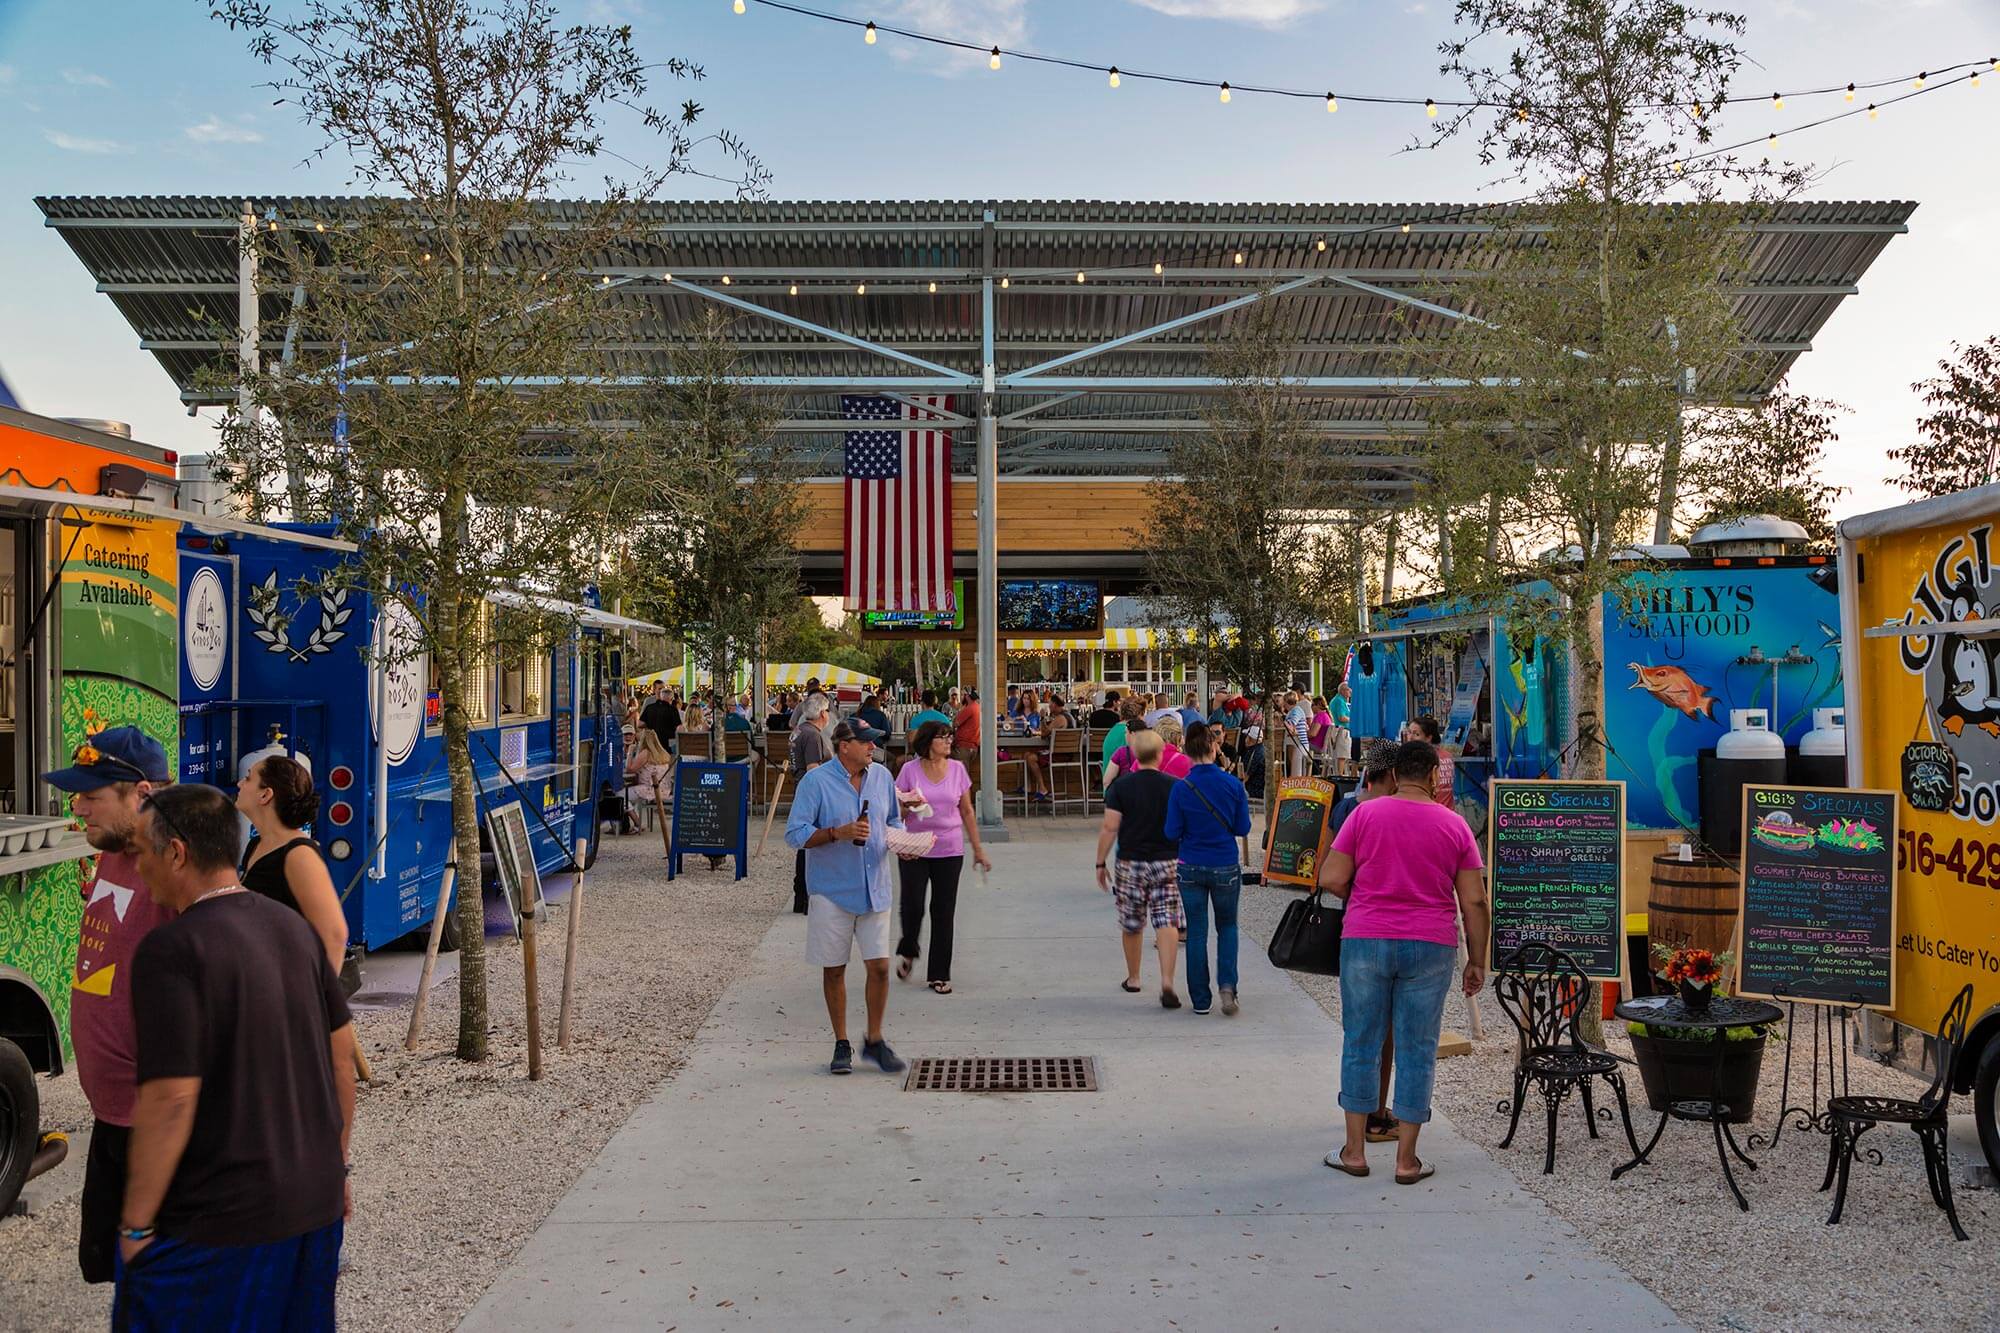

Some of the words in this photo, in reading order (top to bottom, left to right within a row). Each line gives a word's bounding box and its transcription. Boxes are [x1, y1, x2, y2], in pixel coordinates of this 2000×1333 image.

[84, 543, 149, 579] Catering
[80, 579, 153, 607] Available
[1629, 614, 1750, 645] SEAFOOD
[1907, 746, 1949, 764] OCTOPUS
[1281, 779, 1312, 790] SHOCK
[1315, 781, 1332, 793] TOP
[1803, 793, 1885, 816] SPECIALS
[1912, 793, 1943, 808] SALAD
[1499, 814, 1533, 827] GRILLED
[1533, 815, 1554, 827] LAMB
[1555, 815, 1582, 828] CHOPS
[1499, 847, 1528, 857] SPICY
[1530, 846, 1571, 857] SHRIMP
[1570, 854, 1607, 862] GREENS
[1754, 865, 1795, 879] GOURMET
[1798, 869, 1831, 880] ANGUS
[1837, 871, 1886, 883] BURGERS
[1539, 883, 1570, 893] FRENCH
[1571, 883, 1597, 894] FRIES
[1495, 899, 1525, 909] GRILLED
[1520, 931, 1546, 940] BRIE
[1750, 928, 1778, 937] GARDEN
[1780, 929, 1803, 939] FRESH
[1835, 932, 1870, 941] SALADS
[1917, 935, 1933, 957] Us
[1936, 937, 1975, 966] Cater
[1978, 948, 2000, 972] Yo
[1834, 967, 1866, 976] MUSTARD
